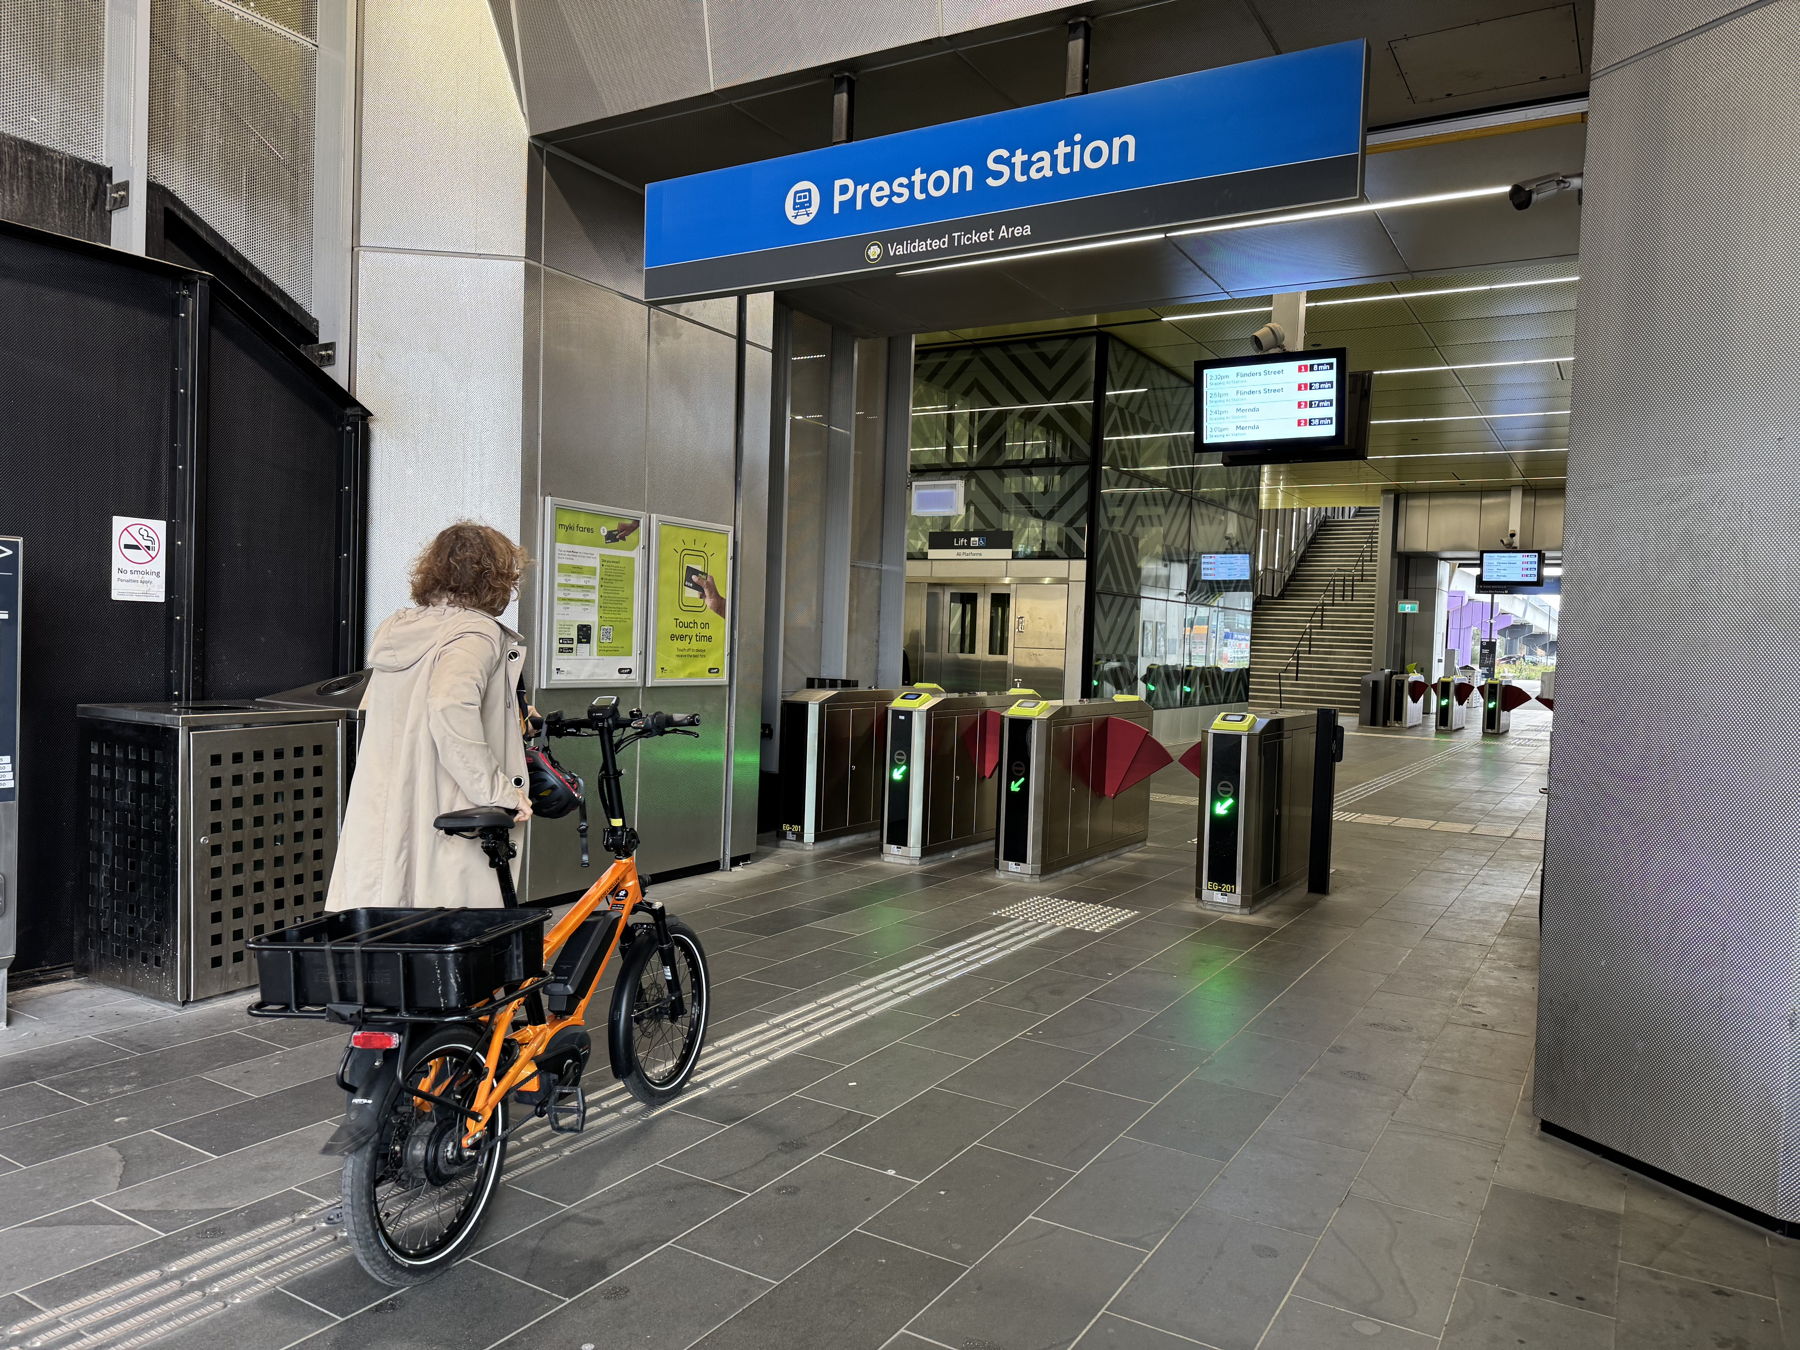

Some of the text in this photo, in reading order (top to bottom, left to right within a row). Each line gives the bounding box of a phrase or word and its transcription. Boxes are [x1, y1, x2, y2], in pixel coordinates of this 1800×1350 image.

[833, 133, 1136, 214] Preston Station
[888, 224, 1032, 256] Validated Ticket Area
[558, 523, 594, 533] myki fares
[954, 538, 968, 546] Lift
[130, 569, 161, 578] smoking
[674, 618, 698, 629] Touch
[670, 633, 713, 644] every time
[782, 823, 801, 832] EG-201
[1207, 881, 1235, 893] EG-201
